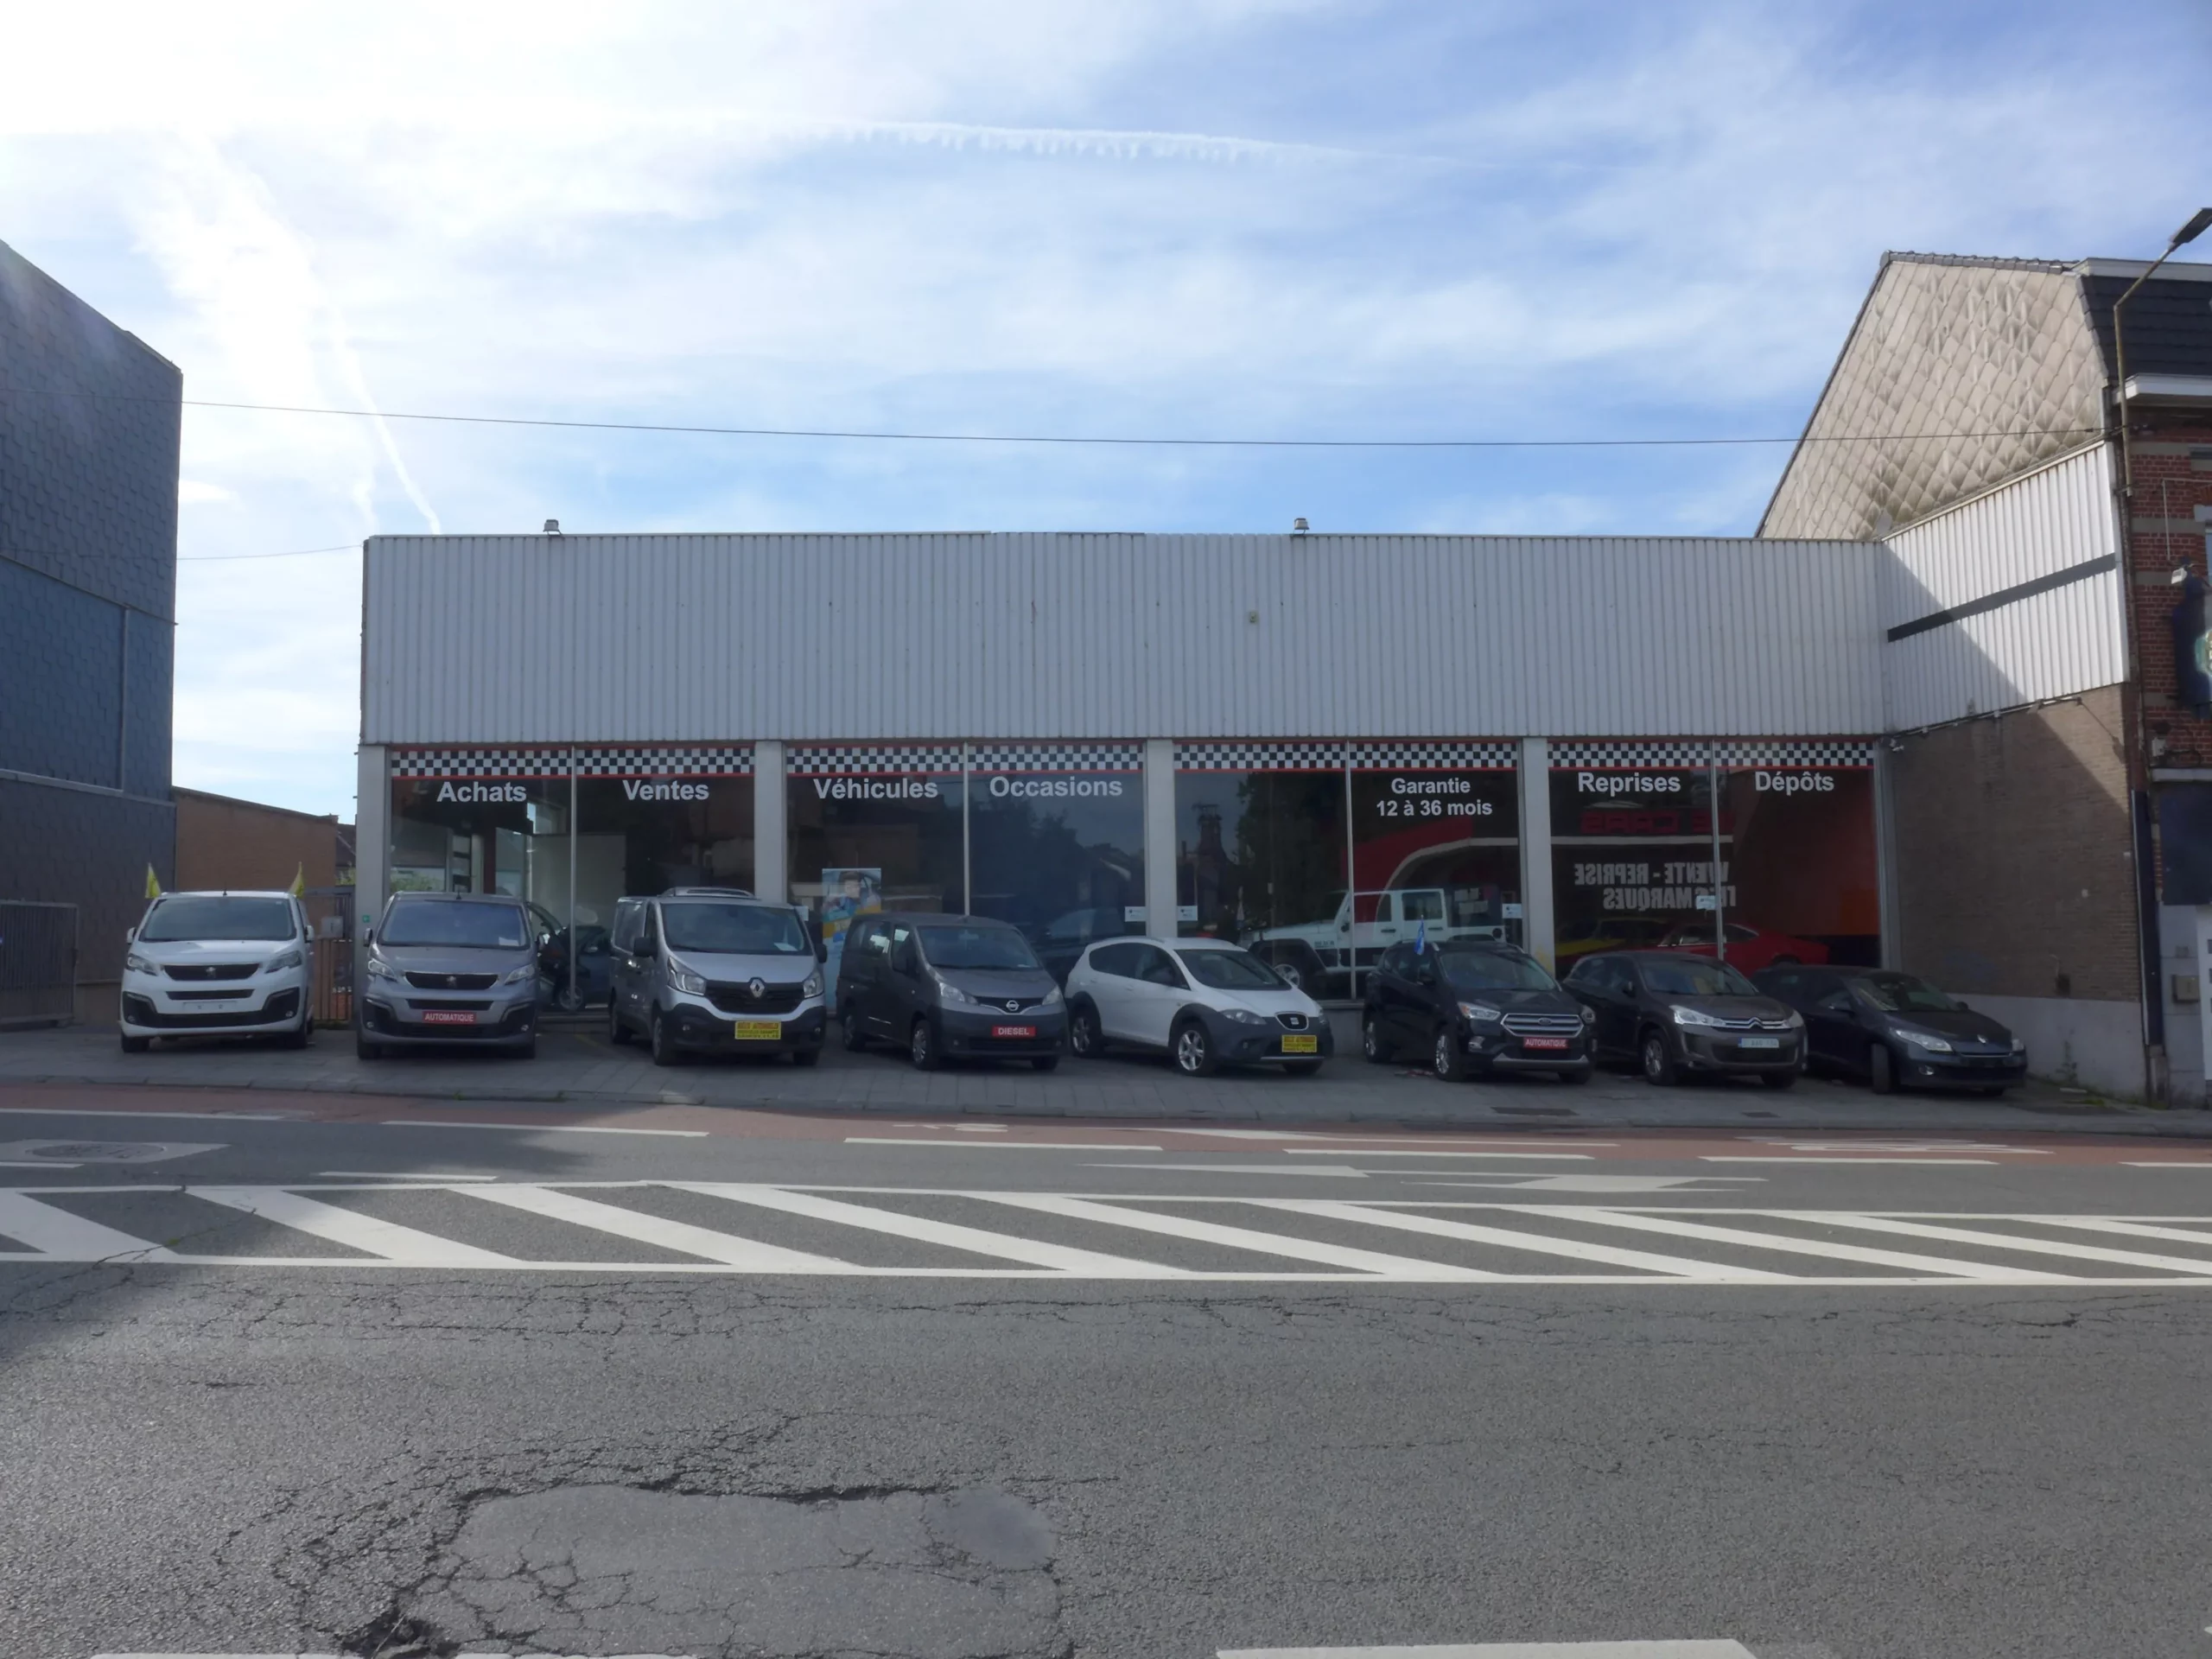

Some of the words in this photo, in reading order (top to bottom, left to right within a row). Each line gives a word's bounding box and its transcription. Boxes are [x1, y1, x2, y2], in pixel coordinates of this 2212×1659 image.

[437, 781, 527, 803] Achats
[622, 779, 709, 800] Ventes
[813, 777, 938, 798] Véhicules
[989, 776, 1123, 797] Occasions
[1391, 777, 1471, 794] Garantie
[1578, 772, 1681, 797] Reprises
[1755, 771, 1834, 796] Dépôts
[1376, 800, 1397, 817] 12
[1403, 799, 1414, 817] à
[1420, 799, 1442, 817] 36
[1447, 798, 1493, 816] mois
[424, 1013, 474, 1022] AUTOMATIQUE
[997, 1027, 1030, 1036] DIESEL
[1525, 1039, 1567, 1048] AUTOMATIQUE
